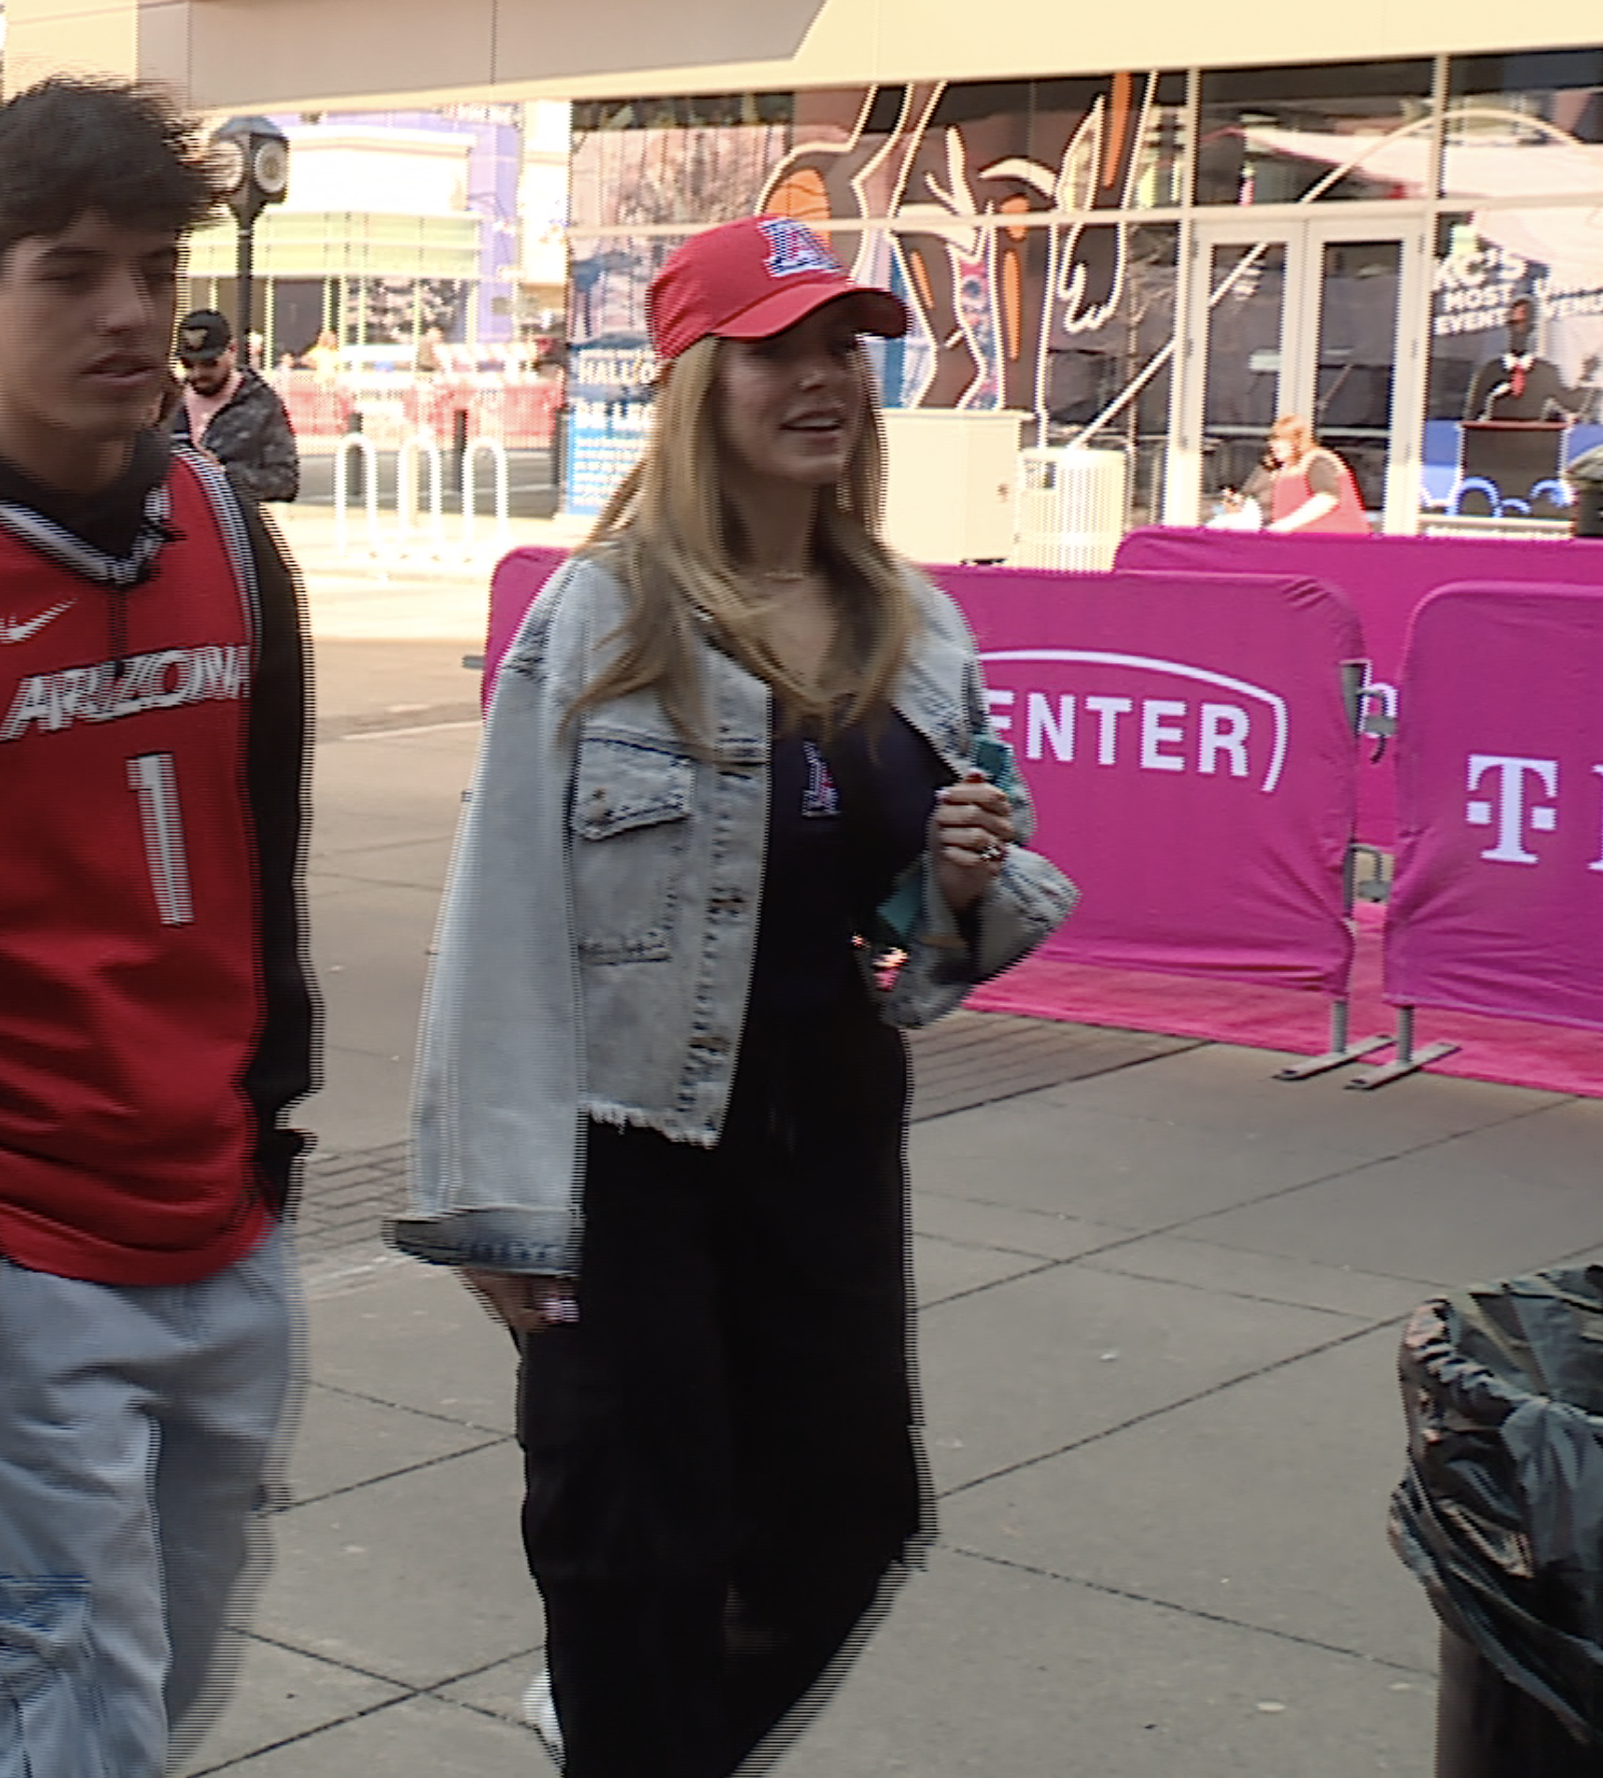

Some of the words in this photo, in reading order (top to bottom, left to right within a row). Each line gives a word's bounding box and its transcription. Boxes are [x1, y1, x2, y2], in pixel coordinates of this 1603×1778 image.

[758, 218, 843, 277] A
[1444, 282, 1515, 314] MOST
[577, 360, 633, 384] HALL
[125, 752, 194, 926] 1
